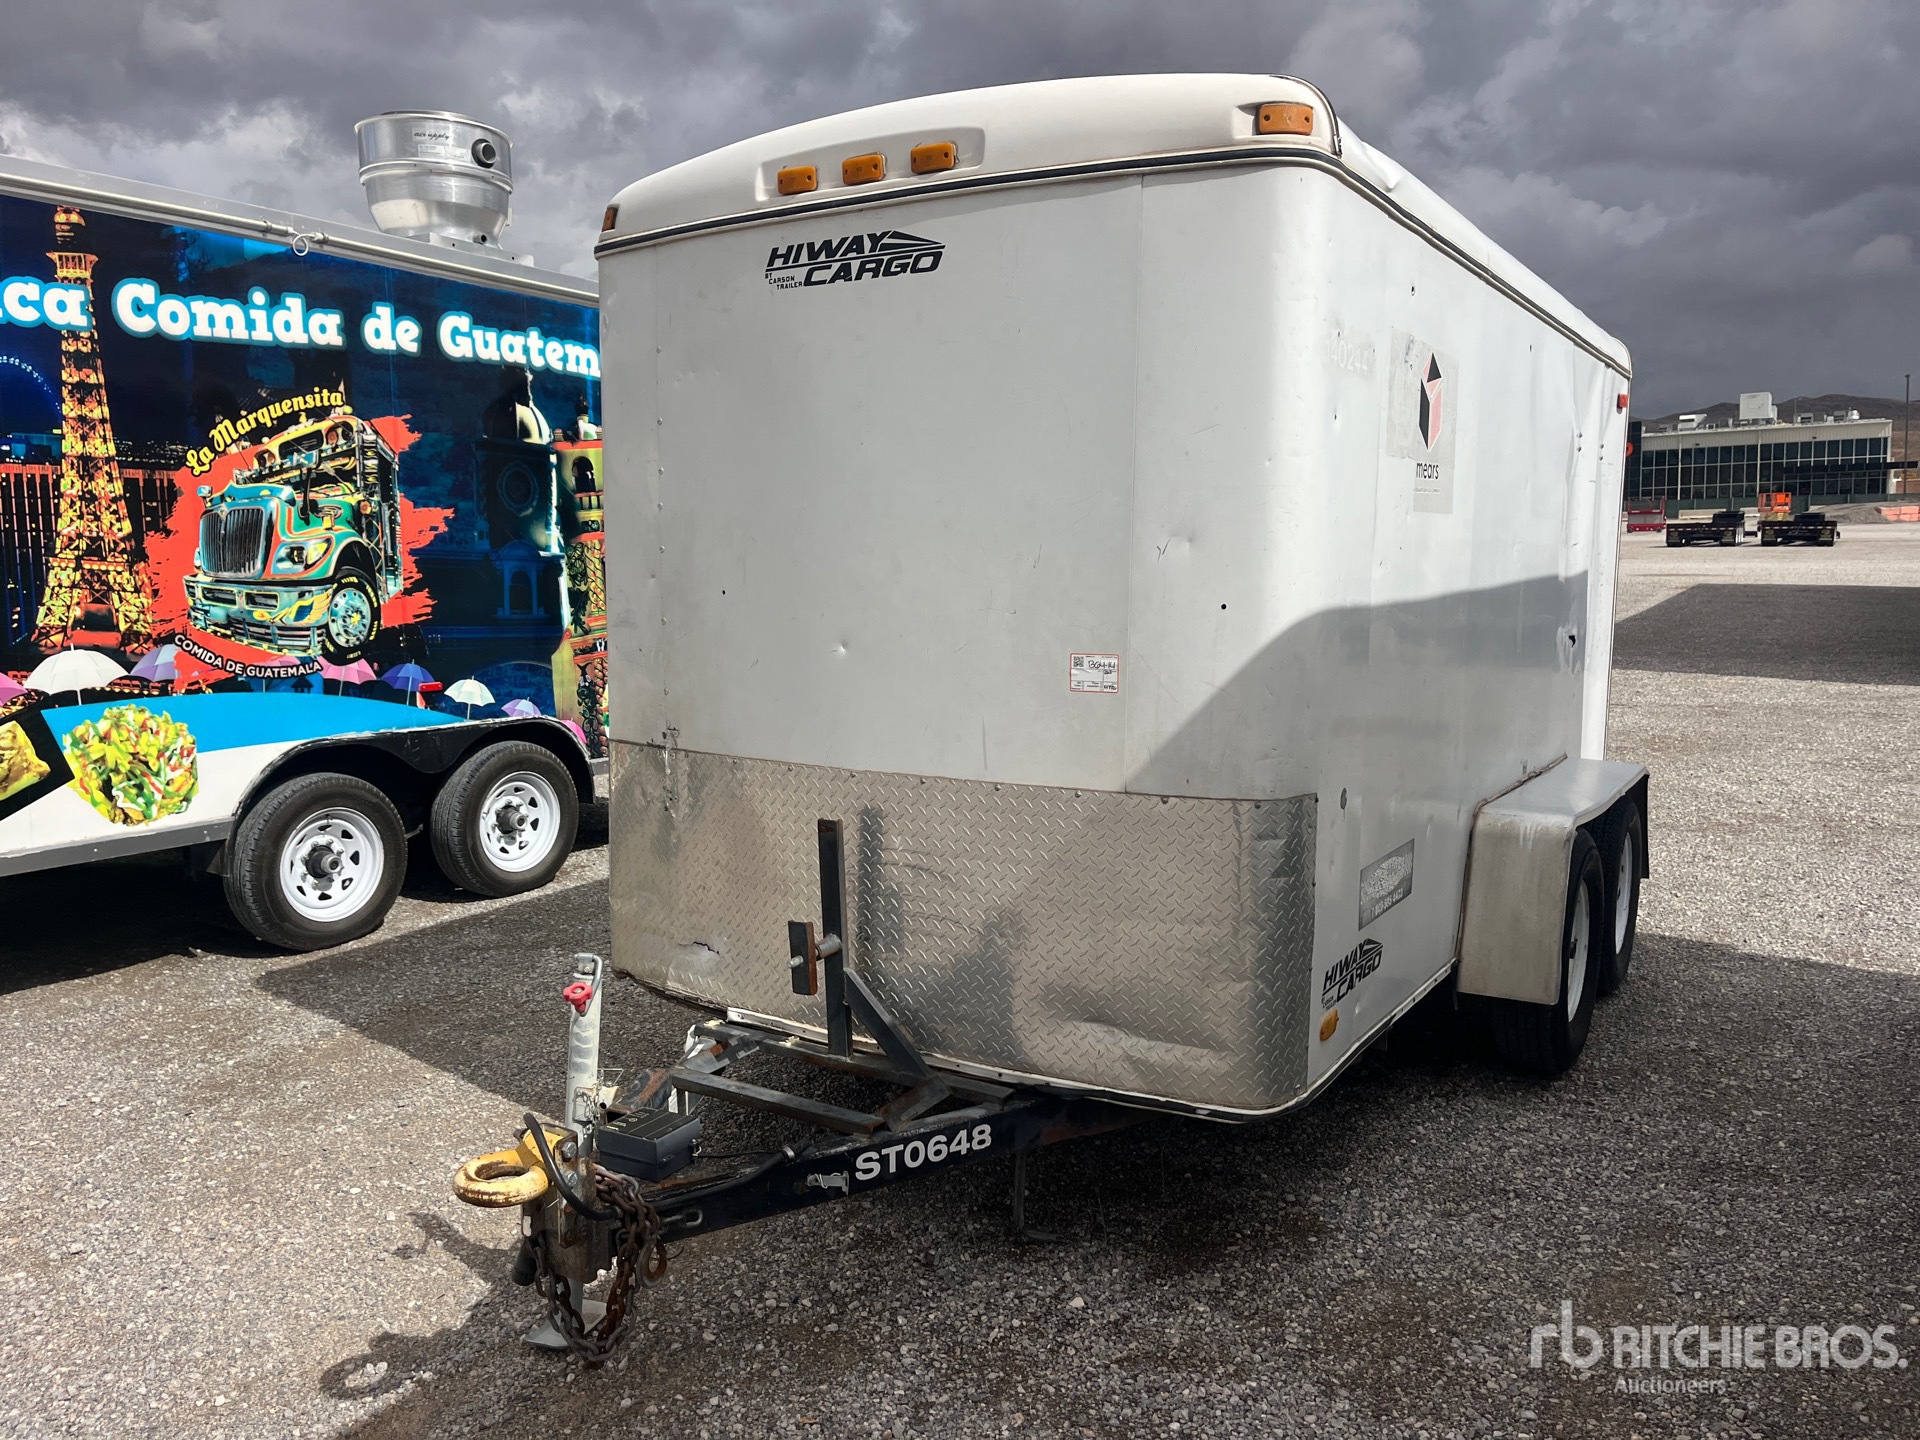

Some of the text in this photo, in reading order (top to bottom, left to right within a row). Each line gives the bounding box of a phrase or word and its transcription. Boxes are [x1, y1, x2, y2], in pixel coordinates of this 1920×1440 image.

[767, 230, 893, 267] HIWAY
[803, 250, 943, 287] CARGO
[769, 275, 795, 284] CARSON
[776, 281, 803, 290] TRAILER
[0, 281, 600, 379] ca Comida de Guatem
[186, 386, 344, 476] La Marquensita
[1415, 462, 1440, 480] mears
[174, 634, 322, 679] COMIDA DE GUATEMALA
[1323, 939, 1367, 992] HIWAY
[1337, 949, 1383, 1003] CARGO
[854, 1123, 993, 1181] ST0648
